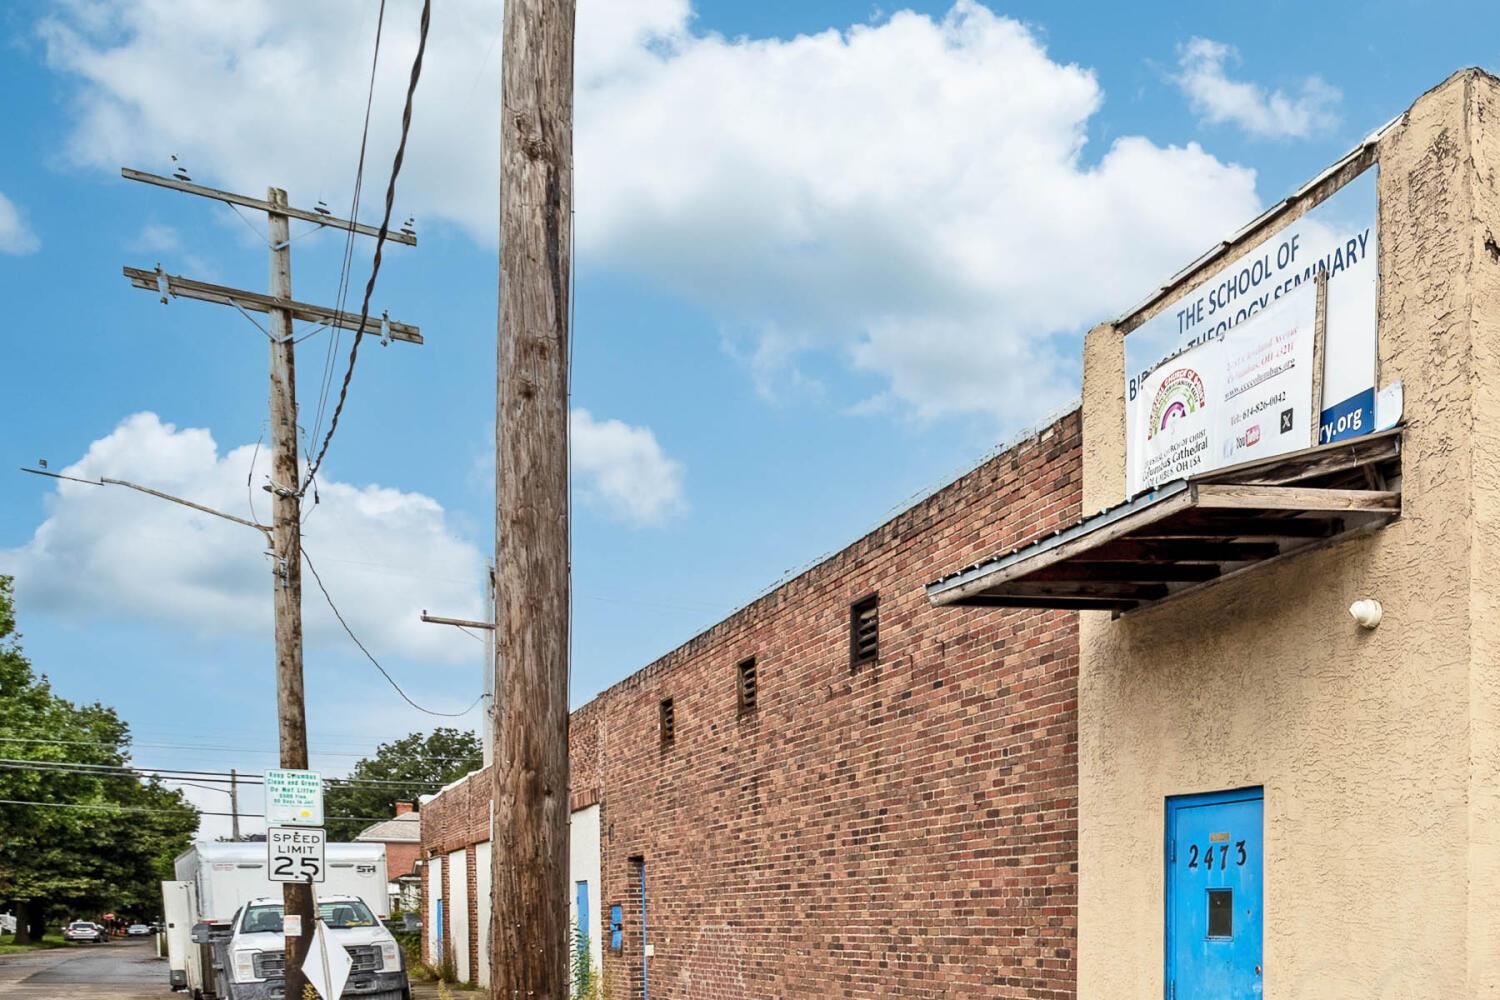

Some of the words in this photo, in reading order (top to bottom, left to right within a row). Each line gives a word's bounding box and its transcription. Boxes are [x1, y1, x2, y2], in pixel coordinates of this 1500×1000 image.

[1177, 297, 1204, 335] THE
[1209, 254, 1272, 315] SCHOOL
[1277, 233, 1300, 270] OF
[273, 833, 320, 844] SPEED
[278, 846, 314, 855] LIMIT
[1188, 839, 1247, 870] 2473
[274, 856, 320, 877] 25
